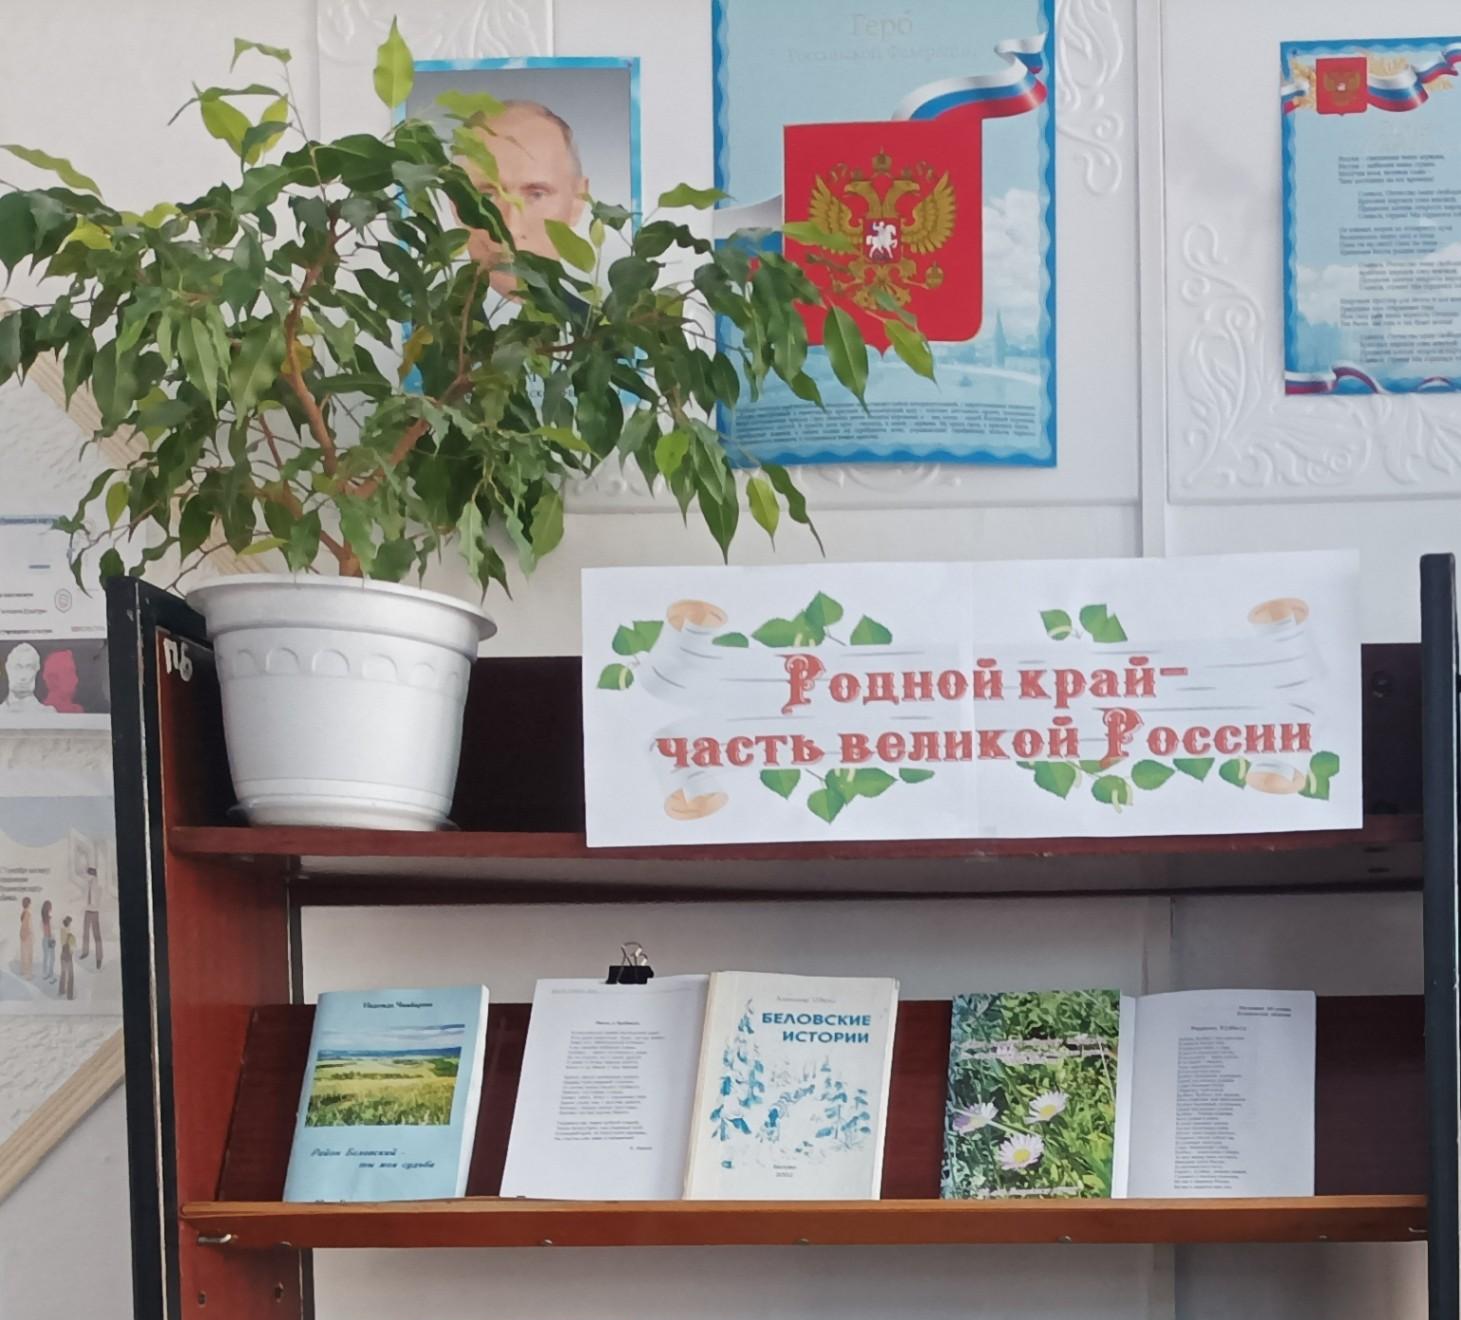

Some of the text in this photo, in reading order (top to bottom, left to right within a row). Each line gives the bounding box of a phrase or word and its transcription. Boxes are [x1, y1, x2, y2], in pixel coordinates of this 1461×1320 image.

[781, 653, 1004, 715] Родной
[655, 706, 1313, 770] часть великой России
[762, 1012, 871, 1026] БЕЛОВСКИЕ
[782, 1030, 869, 1043] ИСТОРИИ
